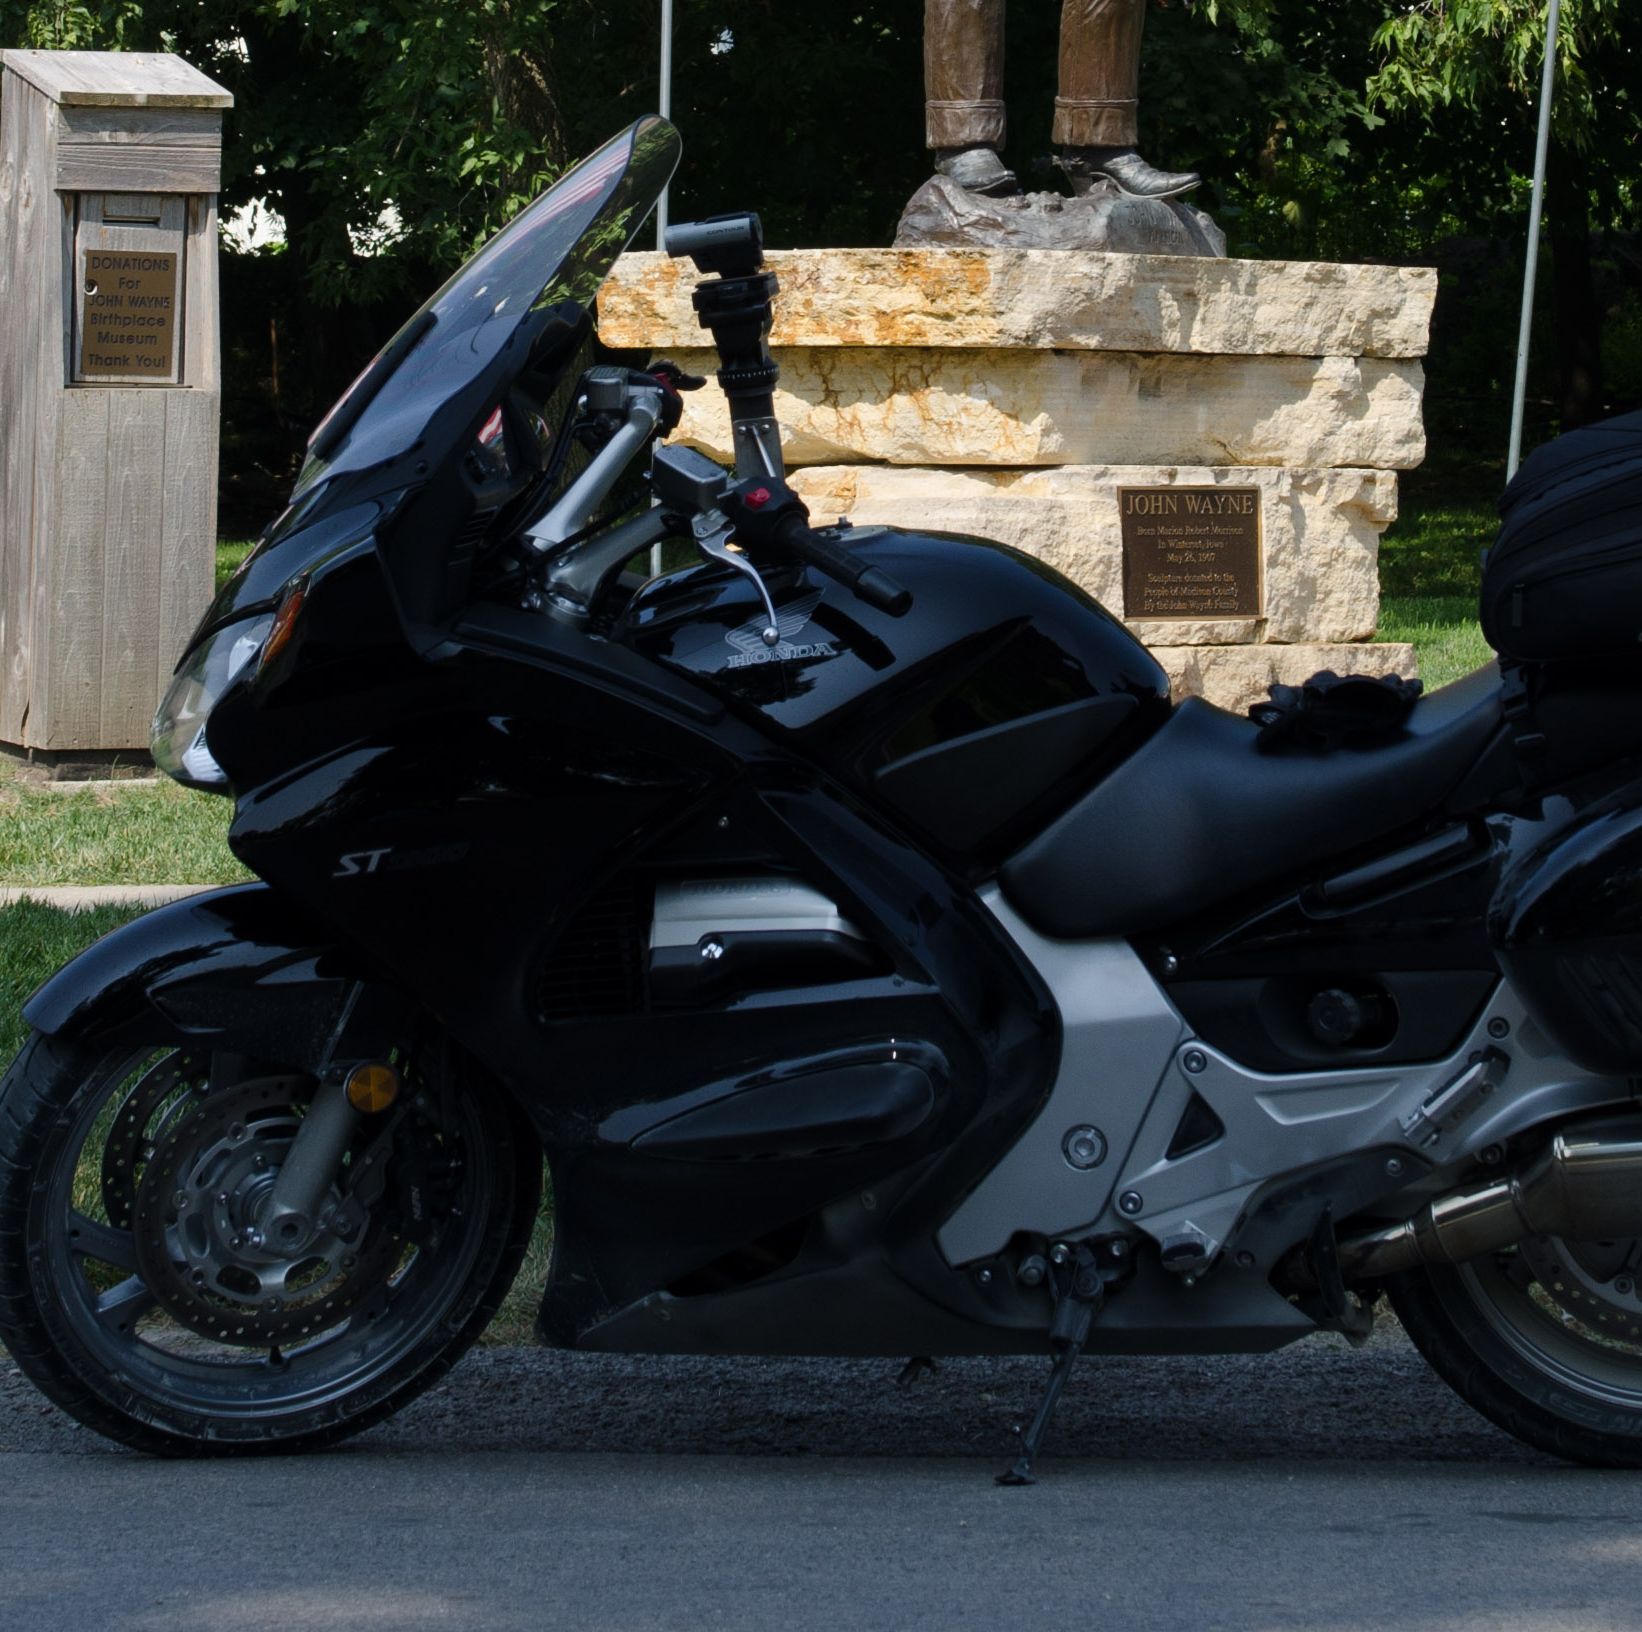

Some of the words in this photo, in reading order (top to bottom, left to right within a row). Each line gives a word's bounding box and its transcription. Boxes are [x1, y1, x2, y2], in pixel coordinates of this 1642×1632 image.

[92, 256, 170, 272] DONATIONS
[118, 277, 141, 290] For
[88, 294, 123, 307] JOHN
[128, 296, 171, 309] WAYNE
[91, 312, 166, 328] Birthplace
[97, 331, 157, 345] Museum
[89, 353, 130, 367] Thank
[136, 355, 166, 368] You!
[1126, 494, 1178, 515] JOHN
[1184, 494, 1254, 515] WAYNE
[1157, 526, 1184, 536] Marion
[1184, 526, 1209, 536] Robert
[1211, 525, 1244, 535] Morrison
[1158, 539, 1166, 549] In
[1167, 552, 1182, 564] May
[1198, 552, 1216, 562] 1907
[1147, 573, 1182, 584] Sculpture
[1184, 572, 1212, 582] donated
[1214, 573, 1222, 582] to
[1223, 572, 1234, 582] the
[1144, 587, 1168, 598] People
[1169, 587, 1178, 596] of
[1180, 587, 1212, 596] Madison
[1212, 587, 1238, 597] County
[1156, 600, 1168, 610] the
[1188, 600, 1212, 612] Wayne
[1214, 599, 1239, 611] Family
[726, 642, 839, 669] HONDA
